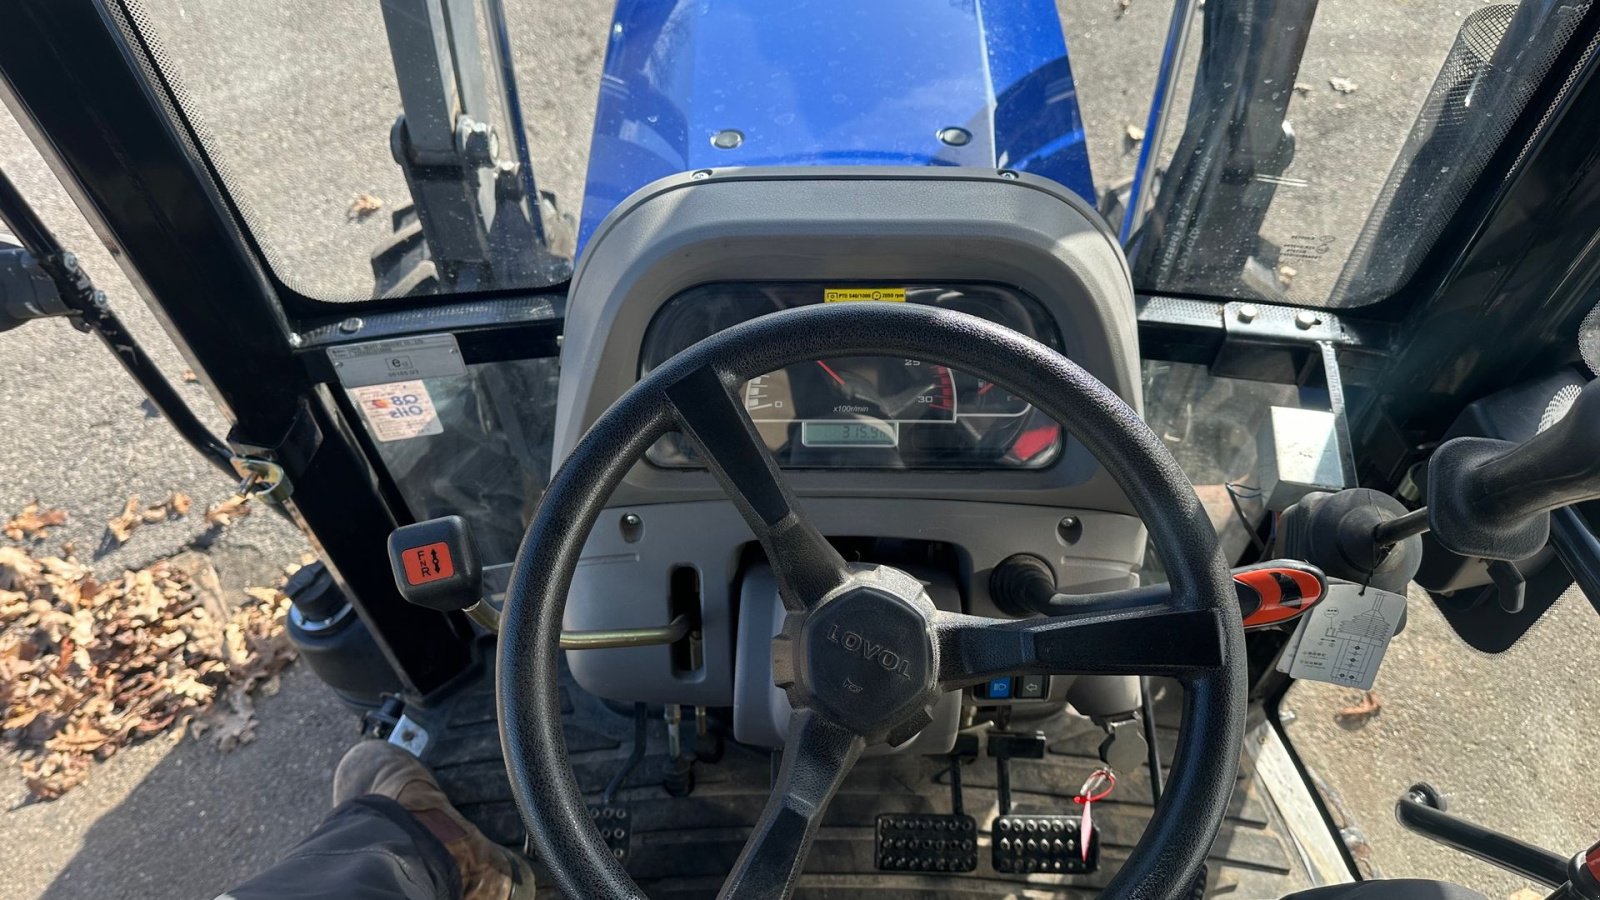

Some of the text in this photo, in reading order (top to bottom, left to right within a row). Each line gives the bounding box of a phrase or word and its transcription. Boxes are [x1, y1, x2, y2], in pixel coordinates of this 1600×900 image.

[904, 358, 921, 366] 25
[917, 395, 933, 403] 30
[826, 624, 912, 680] LOVOL
